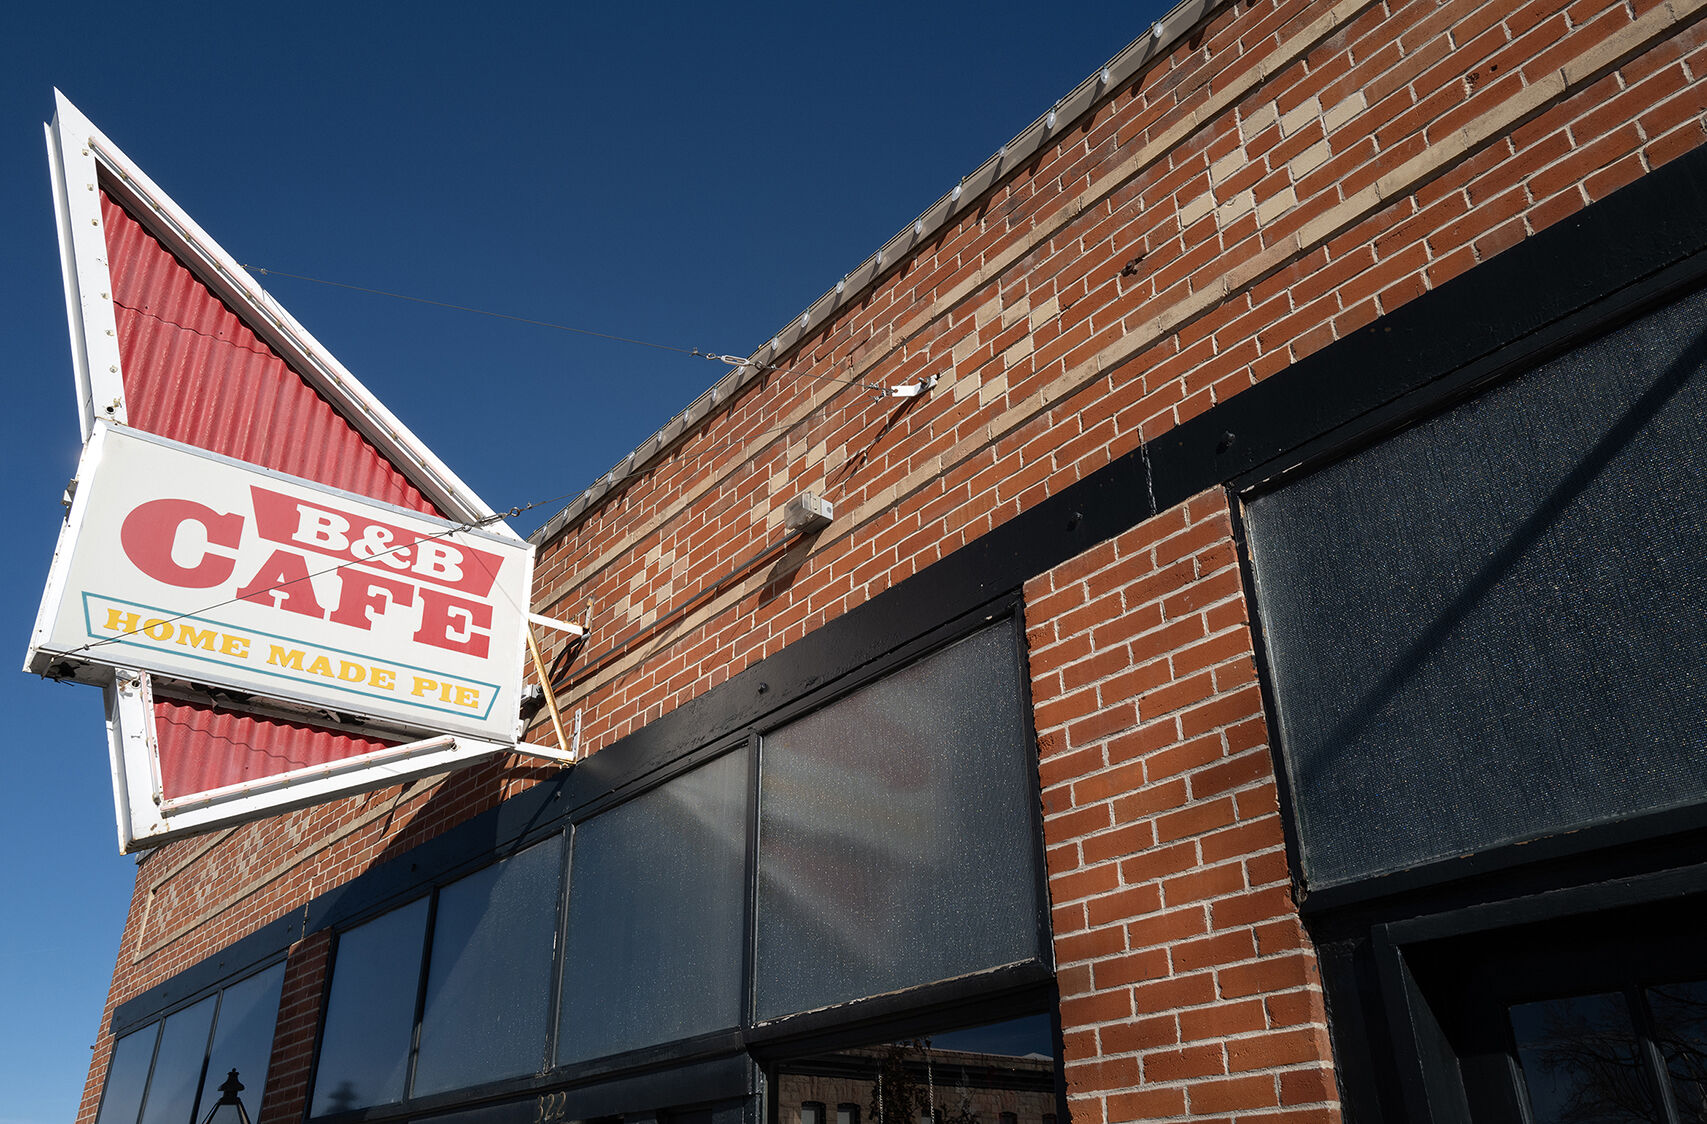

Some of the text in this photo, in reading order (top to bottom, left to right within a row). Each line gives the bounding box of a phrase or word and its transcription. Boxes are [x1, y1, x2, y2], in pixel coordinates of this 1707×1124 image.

[120, 498, 493, 659] CAFE
[292, 504, 464, 582] B&B
[103, 608, 479, 709] HOME MADE PIE
[535, 1091, 567, 1124] 322
